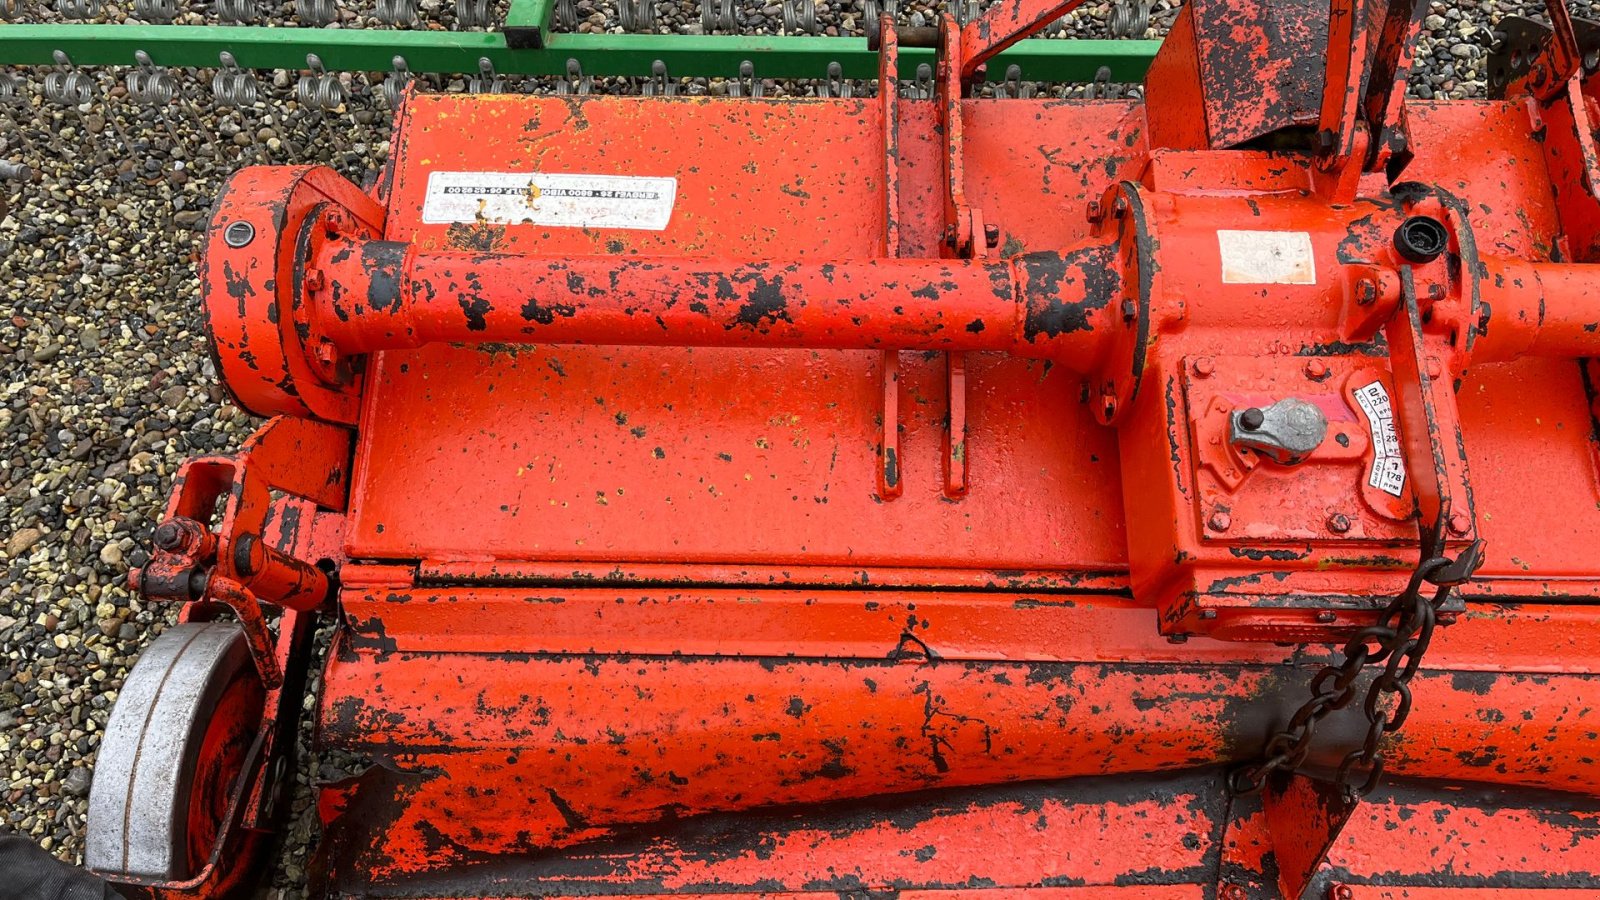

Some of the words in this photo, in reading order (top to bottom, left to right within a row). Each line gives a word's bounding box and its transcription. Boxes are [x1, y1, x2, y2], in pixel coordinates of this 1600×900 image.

[532, 188, 566, 196] VIBO
[568, 189, 593, 197] 8800
[1369, 388, 1379, 396] 2
[1372, 395, 1388, 406] 220
[1387, 471, 1402, 481] 178
